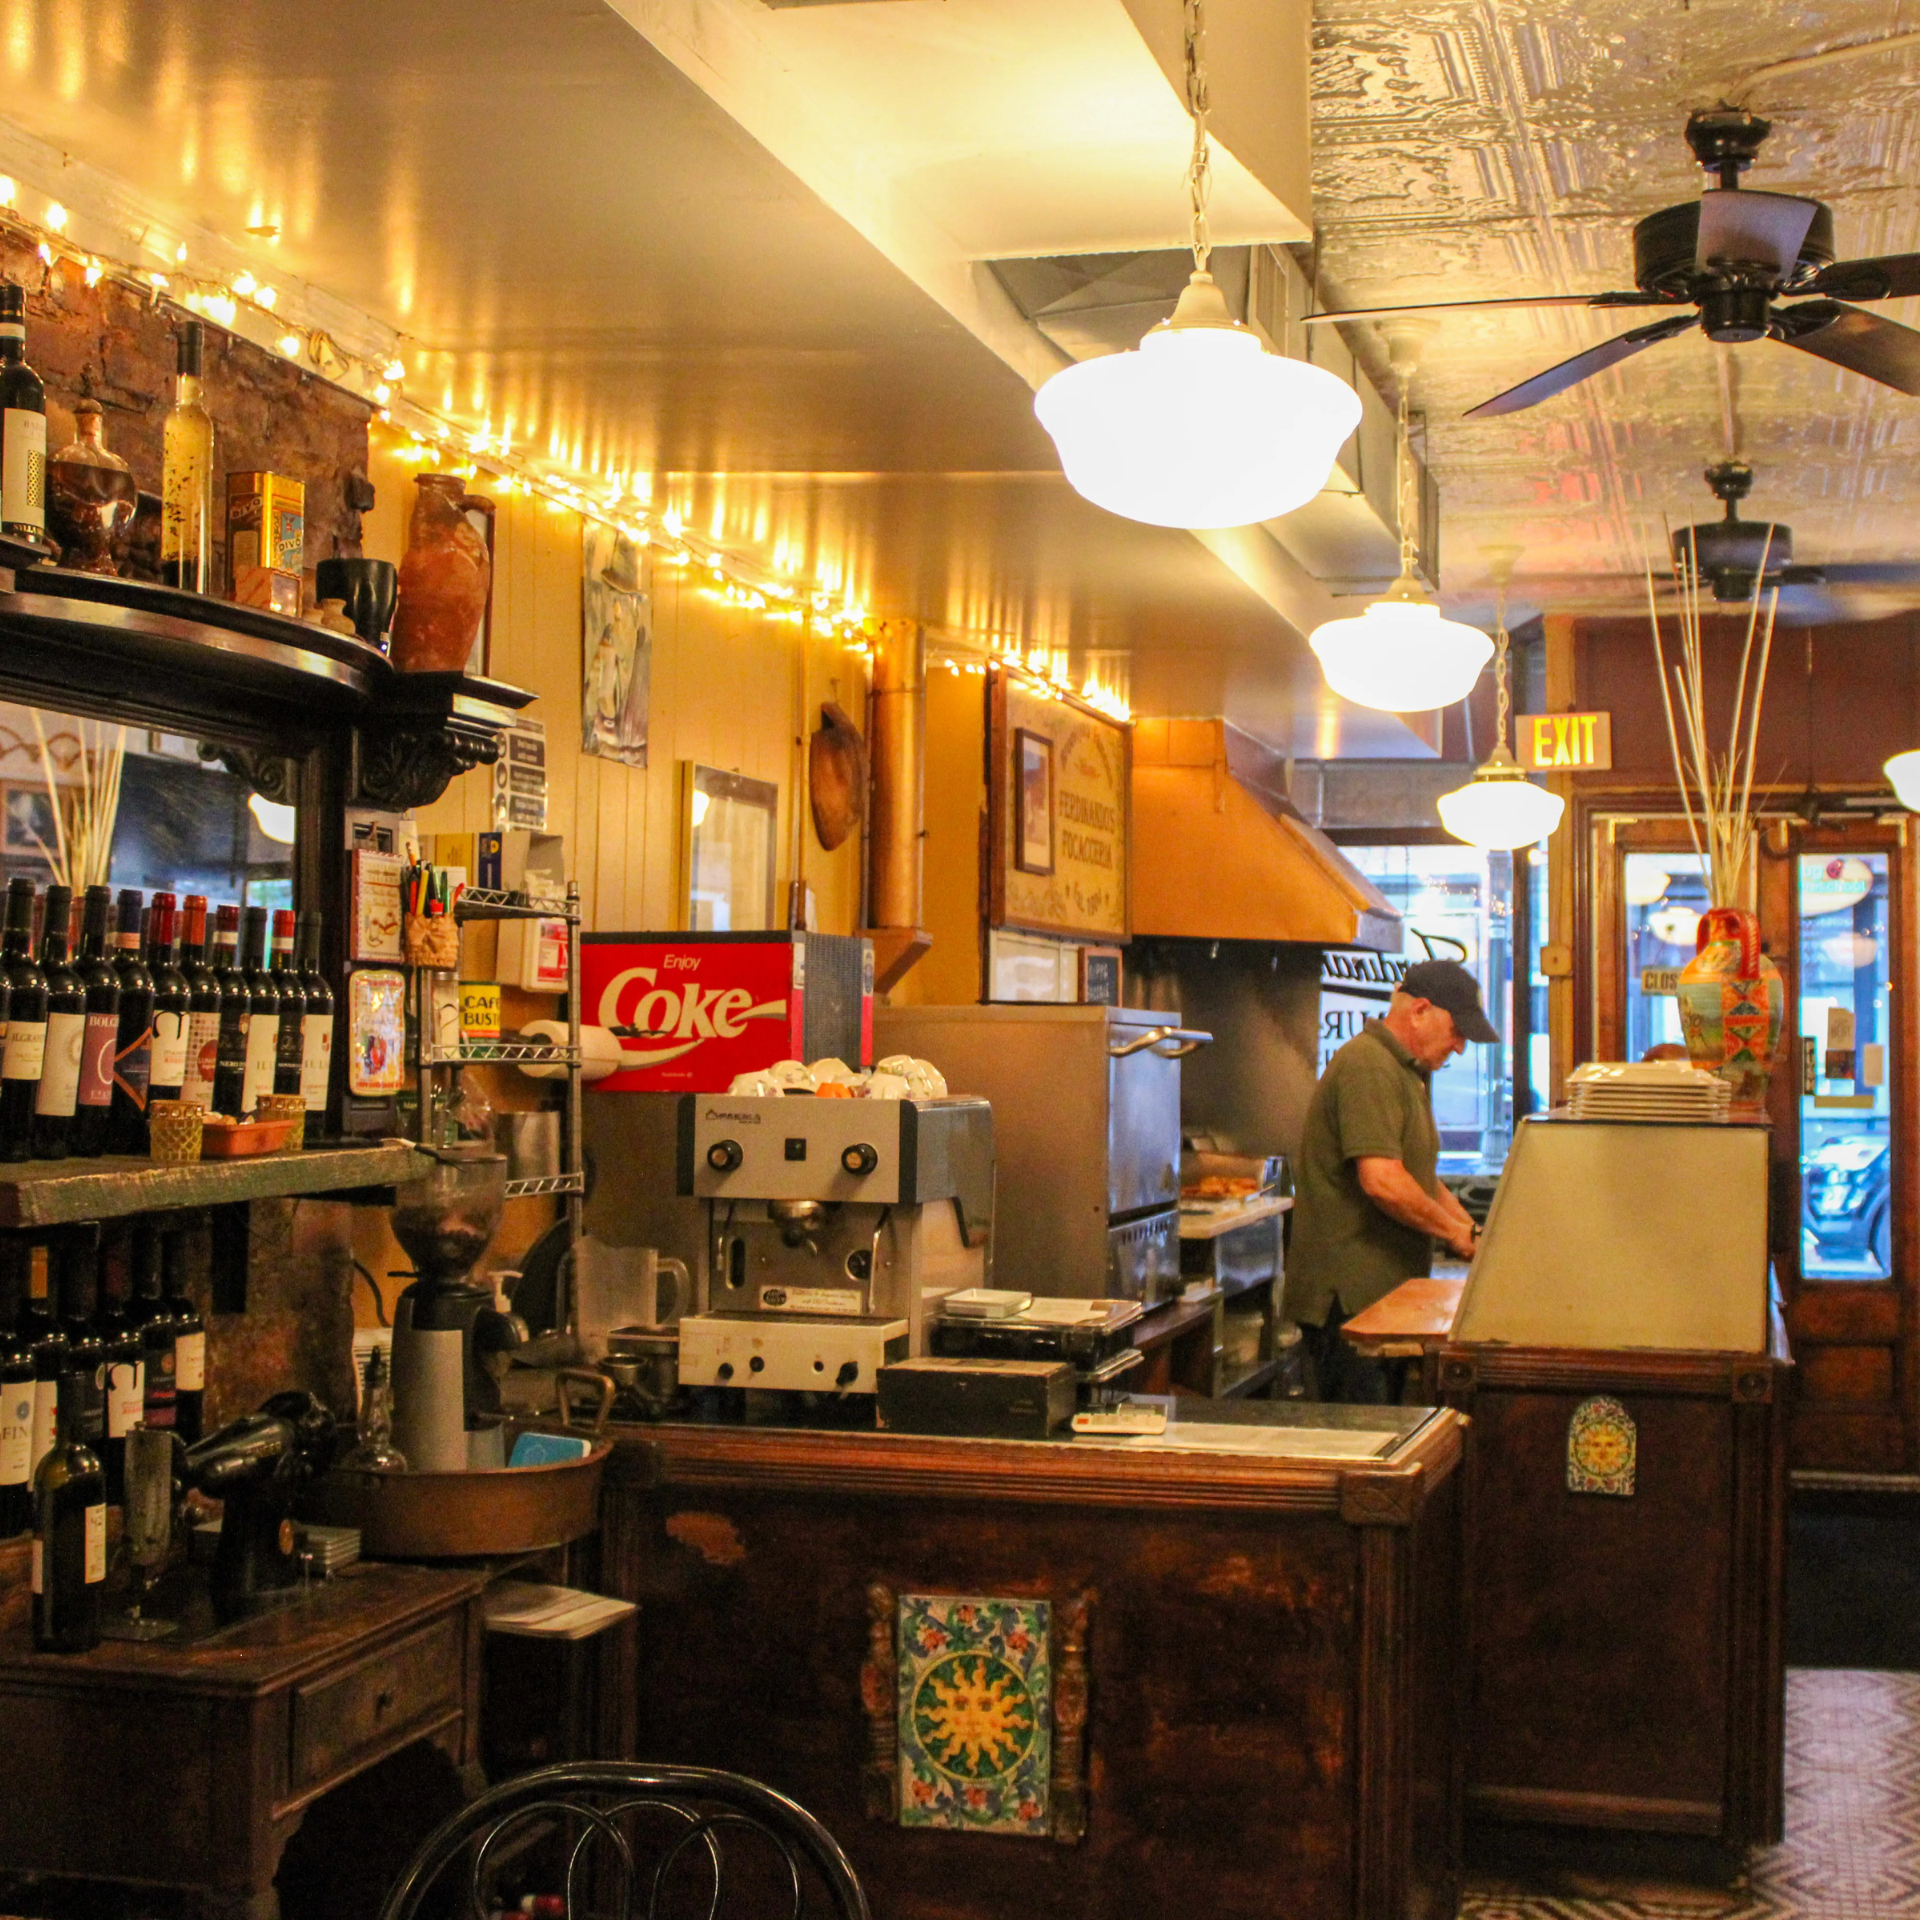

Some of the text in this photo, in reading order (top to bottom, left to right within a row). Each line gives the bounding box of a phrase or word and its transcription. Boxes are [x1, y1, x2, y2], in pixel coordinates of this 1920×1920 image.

[233, 498, 261, 518] DIVO
[279, 538, 302, 552] DIVO
[1533, 715, 1597, 768] EXIT
[663, 954, 701, 971] Enjoy
[598, 967, 752, 1038] Coke
